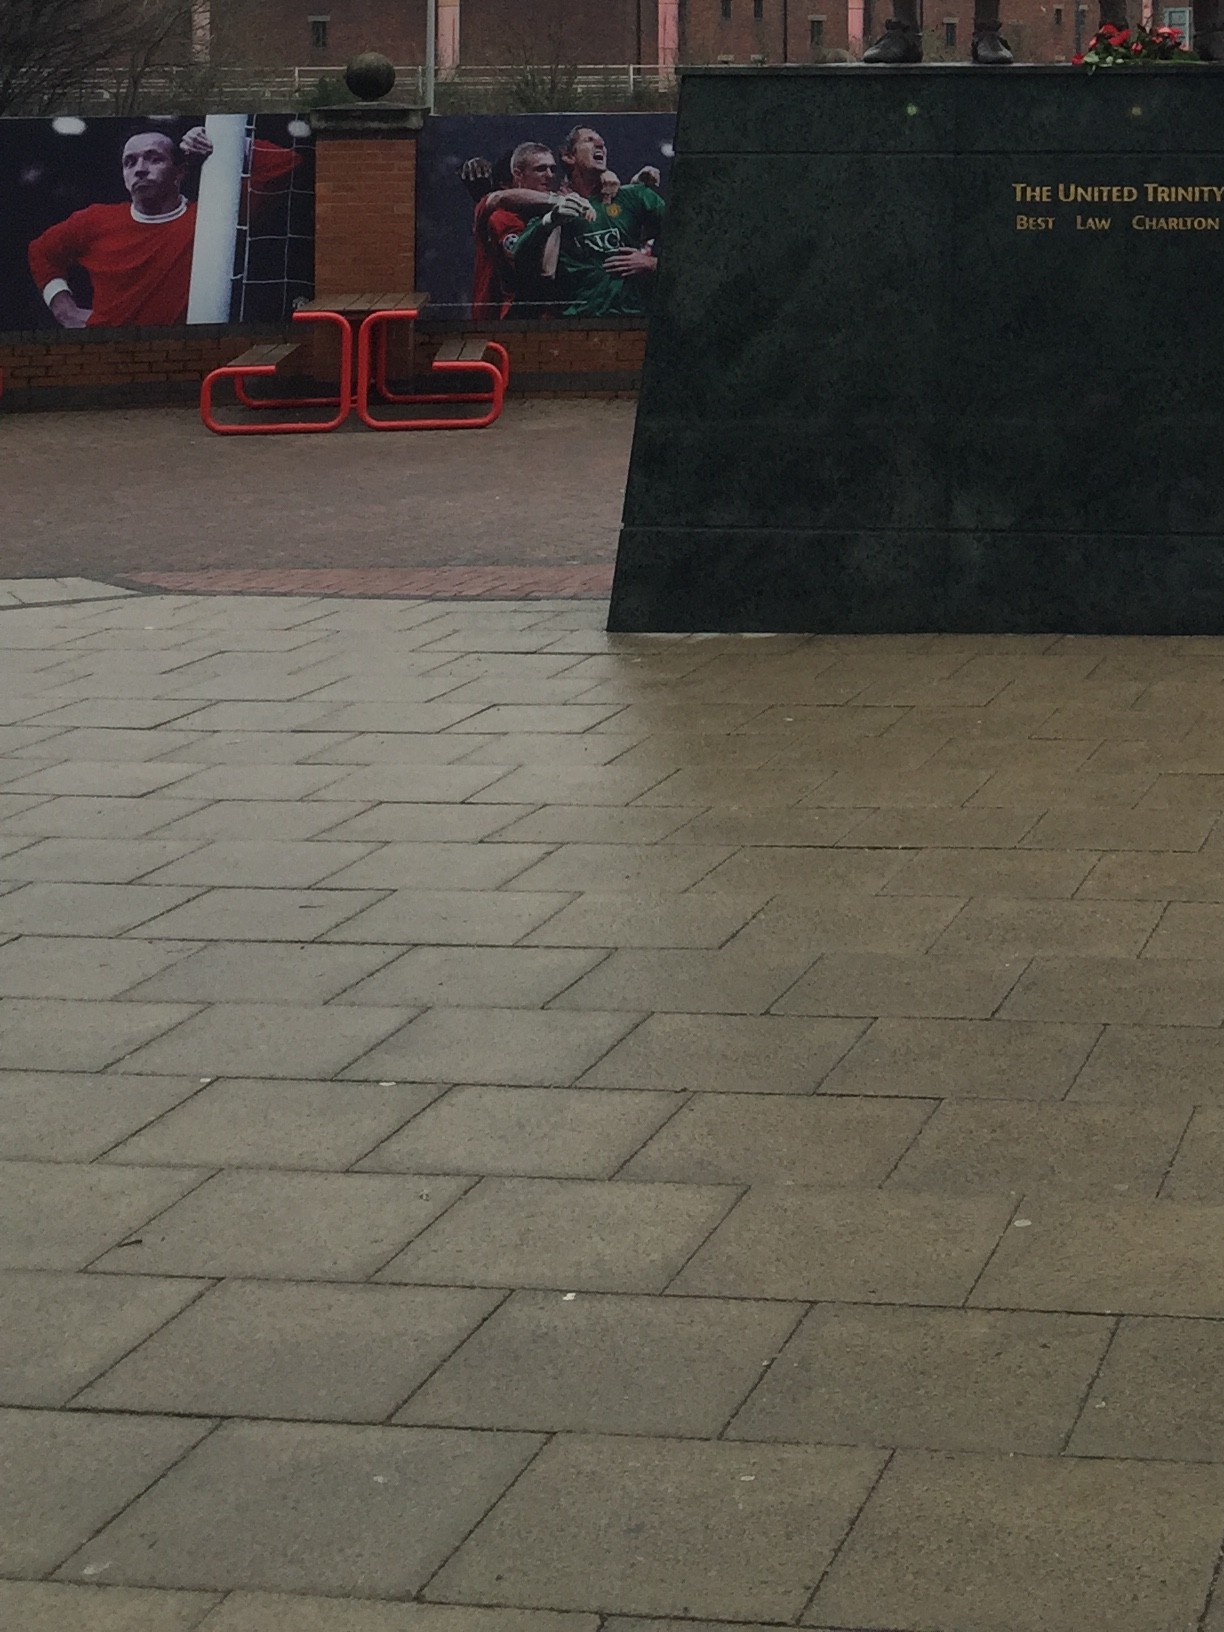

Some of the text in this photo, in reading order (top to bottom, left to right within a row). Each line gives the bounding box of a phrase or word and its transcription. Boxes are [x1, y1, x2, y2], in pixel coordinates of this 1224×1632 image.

[1012, 183, 1224, 202] THE UNITED TRINITY
[1016, 215, 1220, 231] BEST LAW CHARLTON
